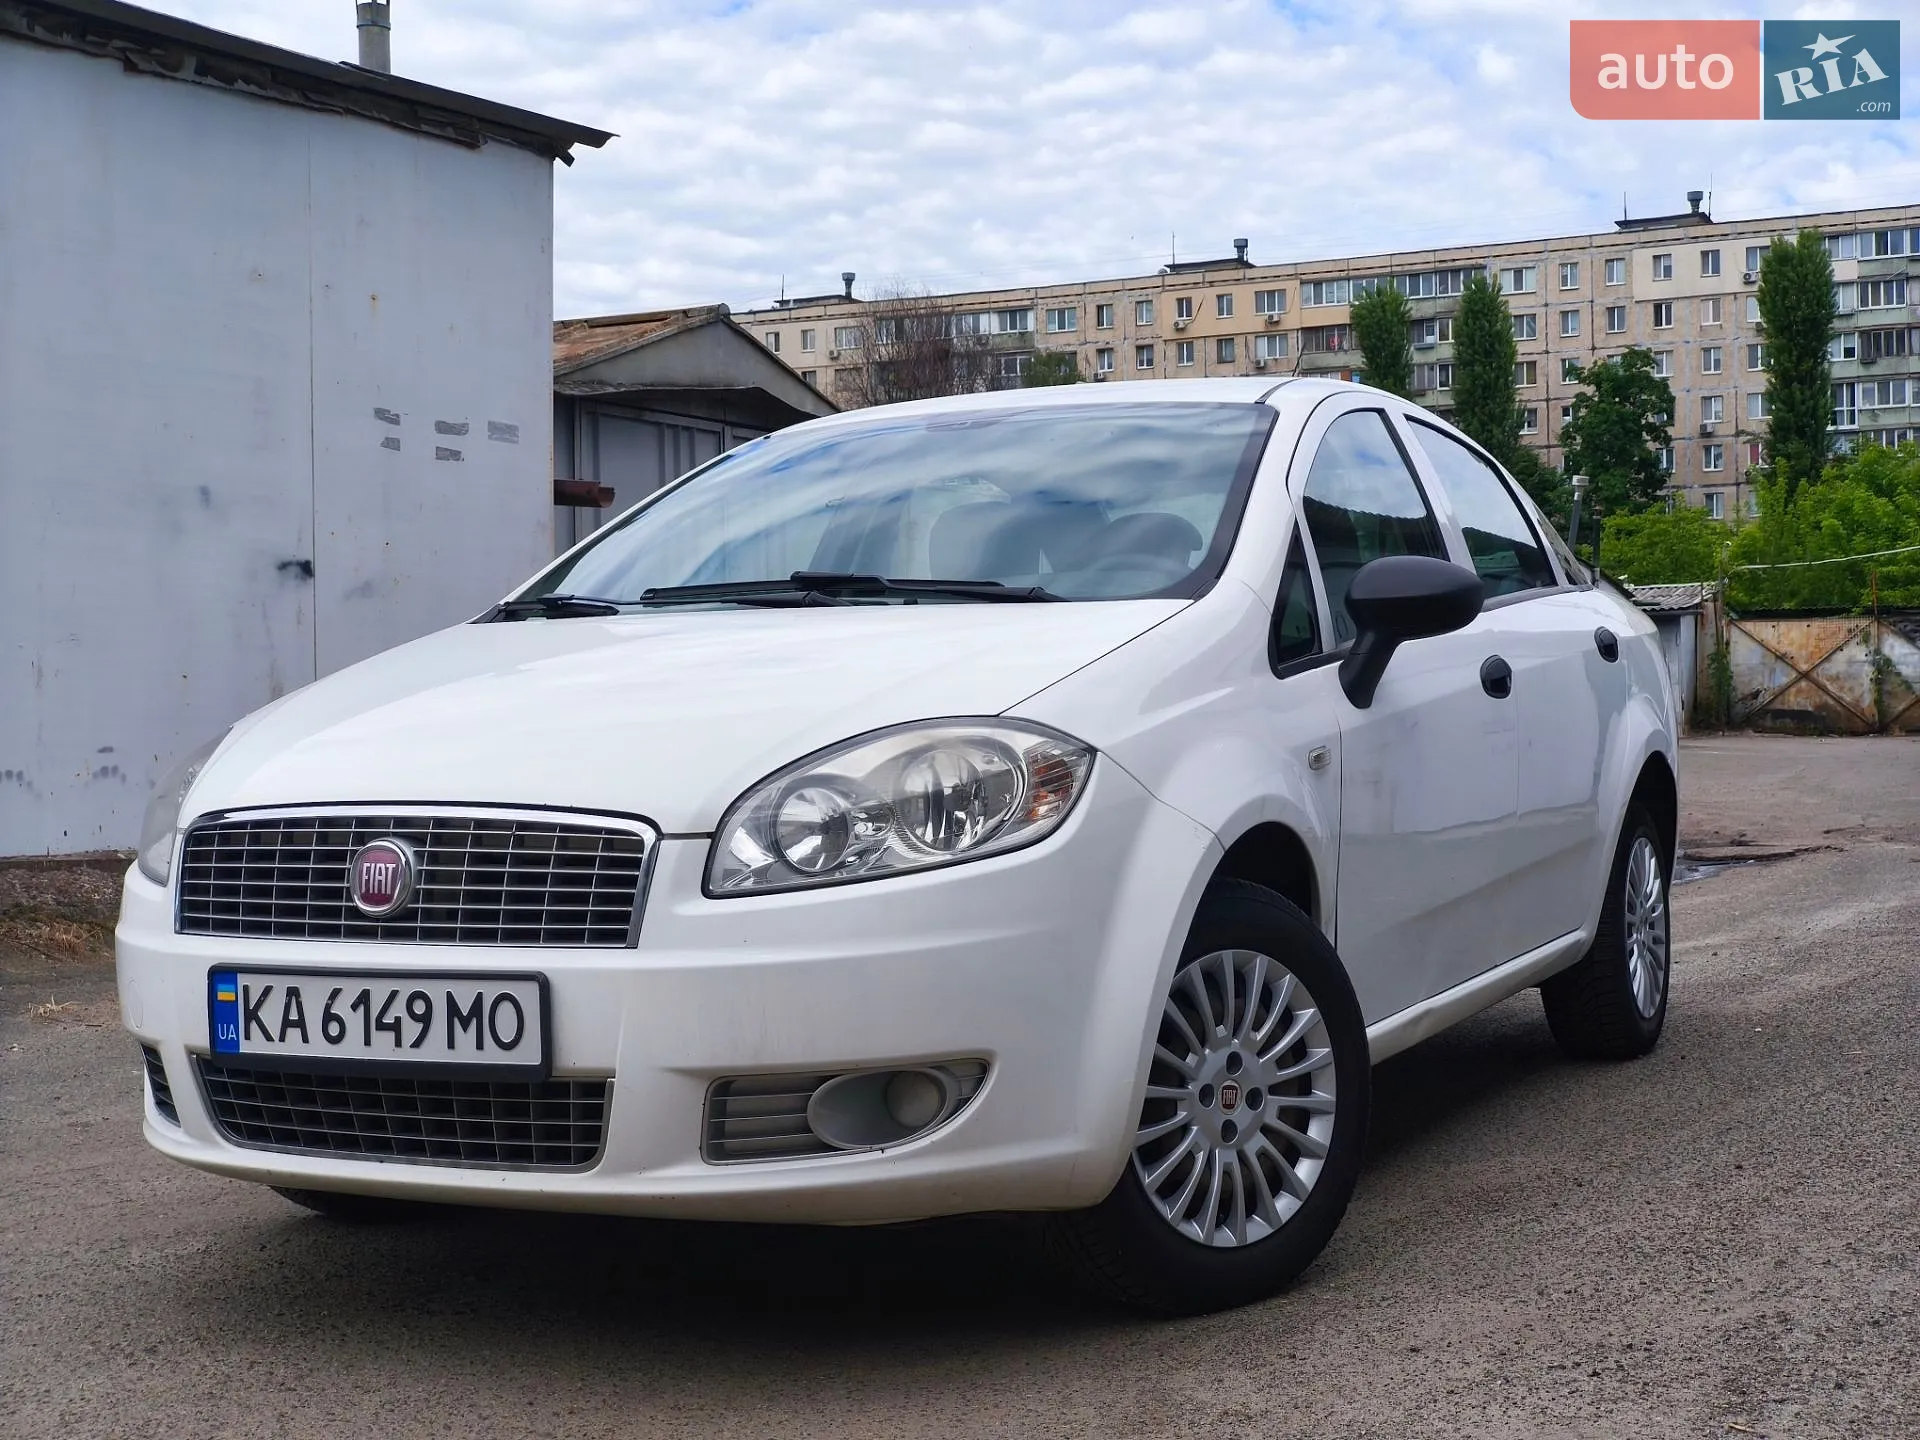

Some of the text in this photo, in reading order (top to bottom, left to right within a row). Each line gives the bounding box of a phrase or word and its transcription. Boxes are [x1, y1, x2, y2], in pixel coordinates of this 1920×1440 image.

[361, 862, 396, 895] FIAT
[242, 984, 525, 1051] KA 6149 MO
[218, 1023, 237, 1041] UA
[1223, 1089, 1237, 1104] FIAT
